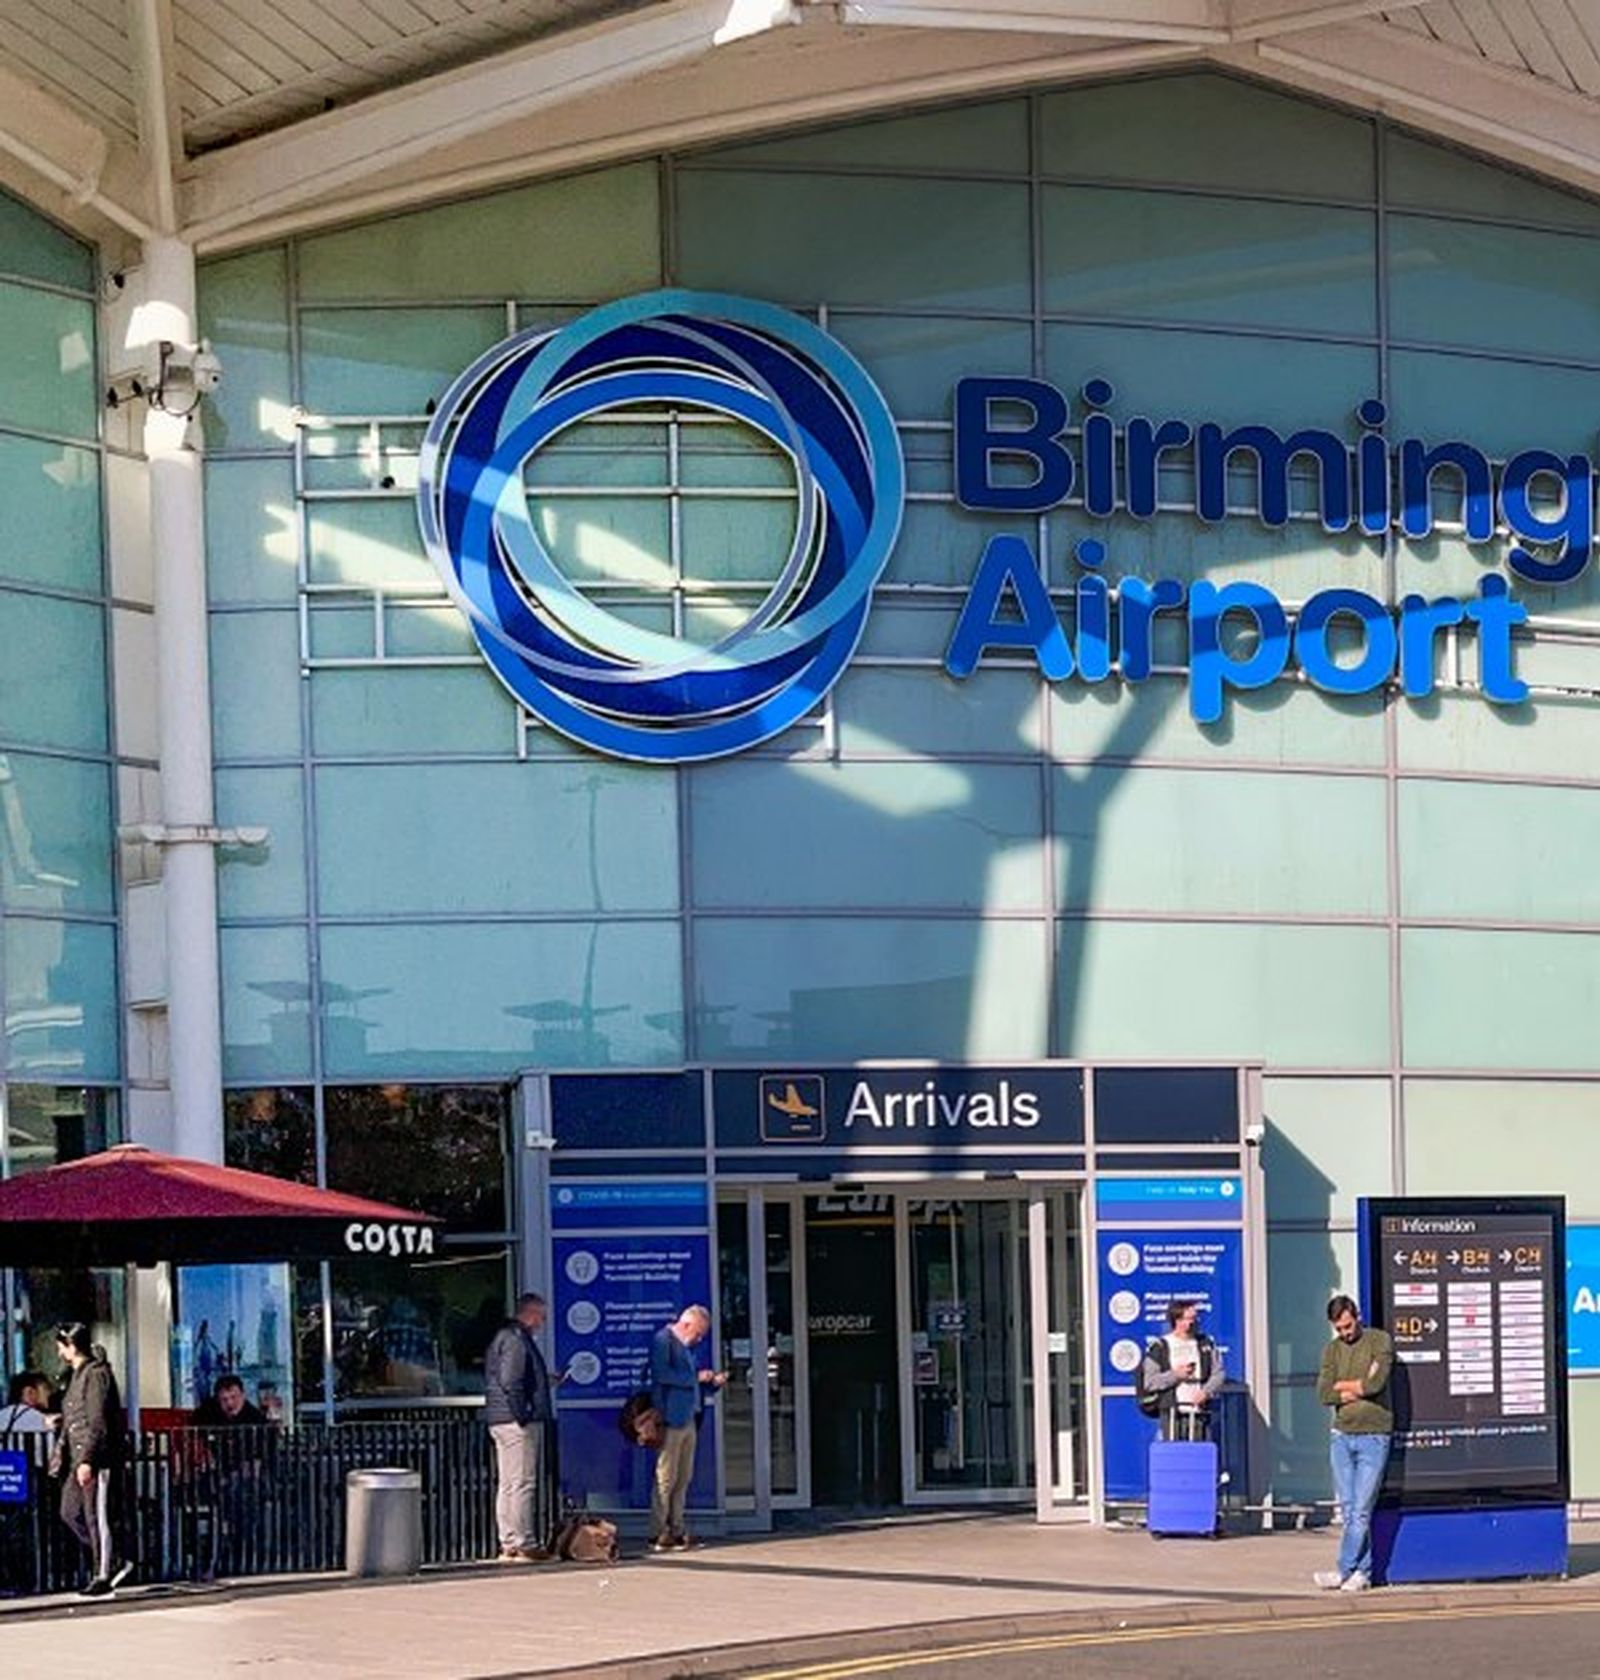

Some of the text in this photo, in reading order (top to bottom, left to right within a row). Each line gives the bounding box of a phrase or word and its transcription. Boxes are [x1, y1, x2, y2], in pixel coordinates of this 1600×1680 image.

[944, 531, 1531, 722] Airport
[843, 1080, 1041, 1128] Arrivals
[343, 1223, 435, 1257] COSTA
[1401, 1217, 1476, 1234] Information
